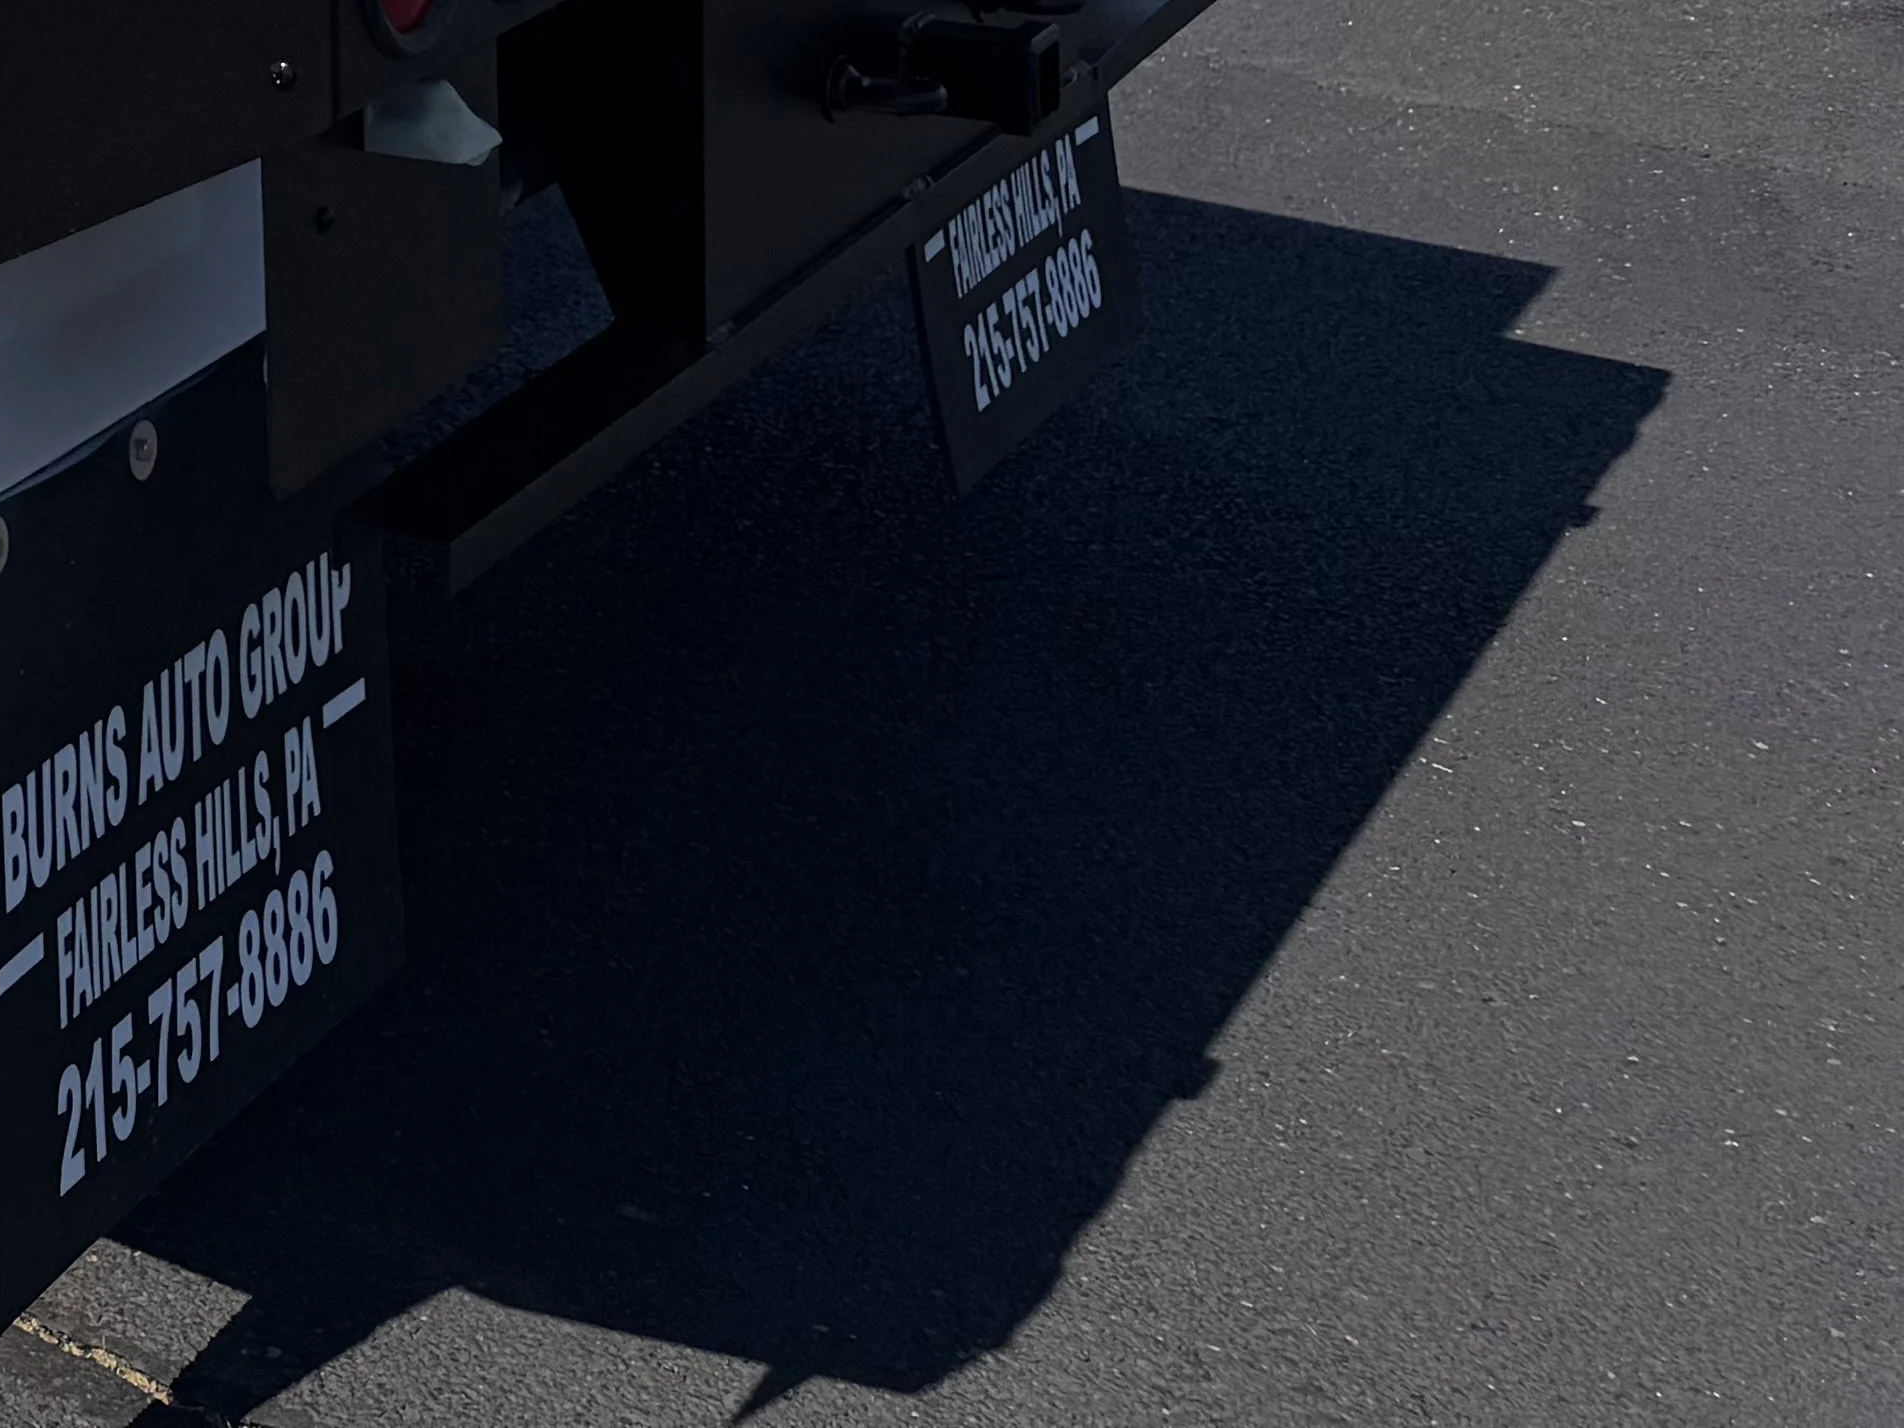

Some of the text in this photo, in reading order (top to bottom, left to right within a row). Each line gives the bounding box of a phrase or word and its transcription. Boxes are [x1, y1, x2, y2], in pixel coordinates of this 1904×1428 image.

[948, 134, 1081, 298] FAIRLESS HILLS, PA
[964, 228, 1102, 412] 215-757-8886
[1, 551, 352, 913] BURNS AUTO GROUP
[56, 715, 322, 1029] FAIRLESS HILLS, PA
[58, 850, 339, 1197] 215-757-8886
